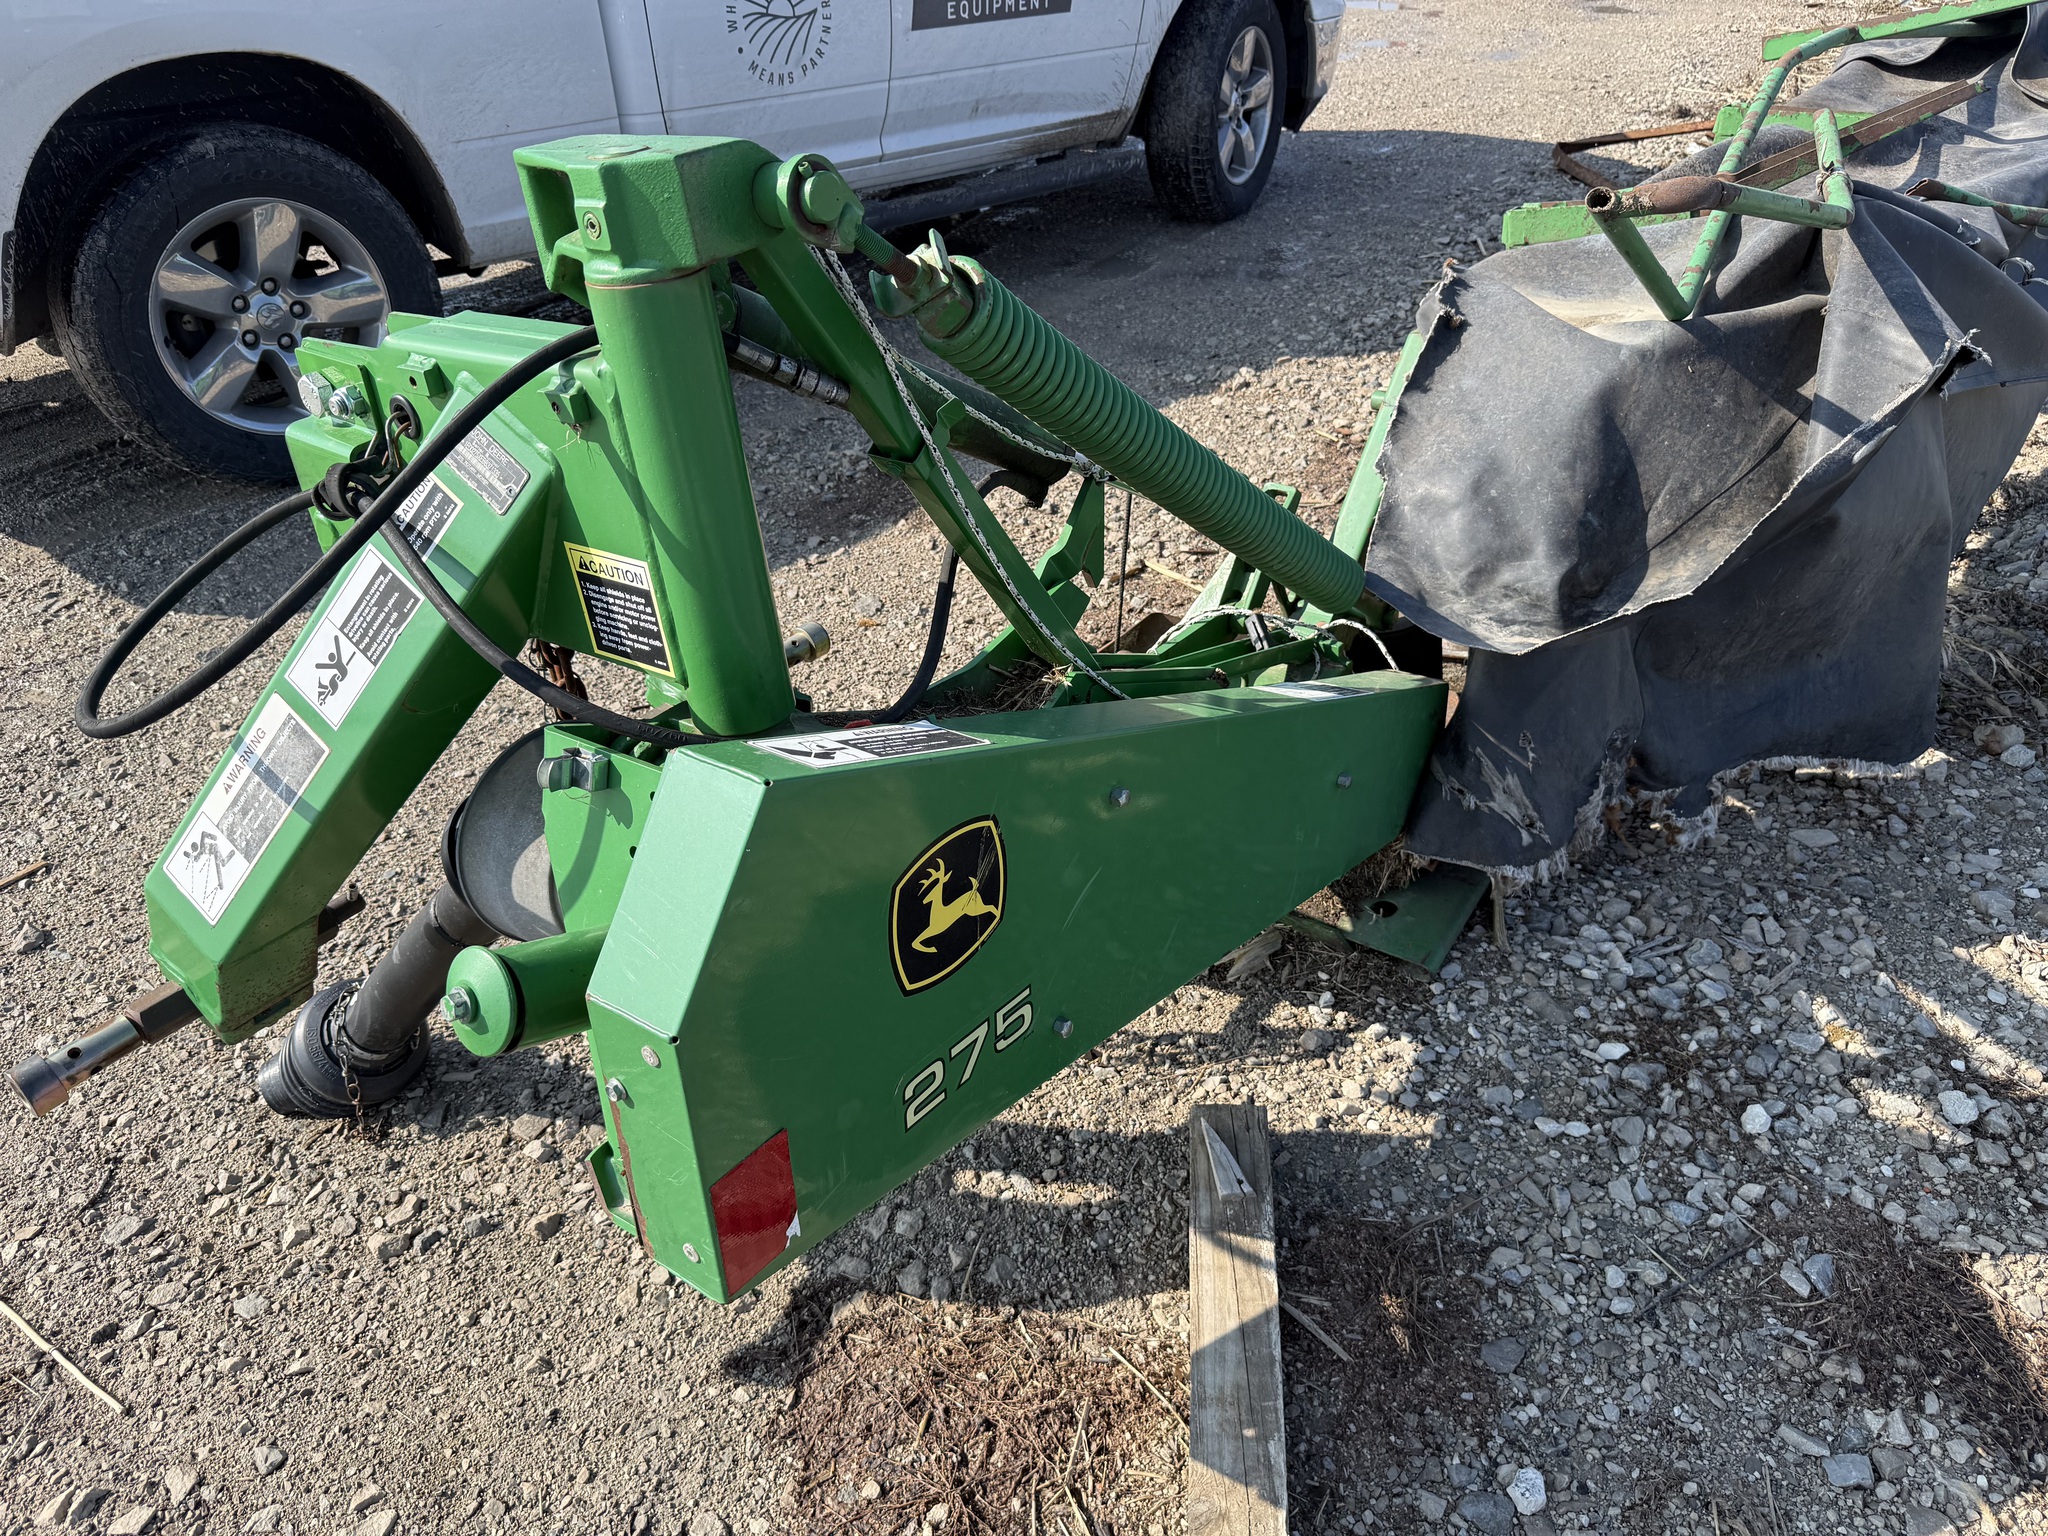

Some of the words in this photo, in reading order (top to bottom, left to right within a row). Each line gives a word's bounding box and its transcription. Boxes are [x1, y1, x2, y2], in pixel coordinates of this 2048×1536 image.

[748, 60, 794, 86] MEANS
[470, 427, 488, 446] JOHN
[489, 445, 509, 466] DEERE
[395, 476, 430, 525] CAUTION
[424, 506, 435, 520] only
[432, 493, 443, 506] with
[413, 538, 422, 551] 540
[422, 526, 432, 538] rpm
[429, 511, 440, 526] PTO
[589, 560, 643, 585] CAUTION
[221, 812, 234, 831] AVOID
[232, 791, 248, 813] INJURY
[246, 774, 259, 792] FROM
[259, 746, 277, 773] THROWN
[275, 717, 296, 747] OBJECTS
[227, 728, 266, 782] WARNING
[903, 983, 1034, 1133] 275
